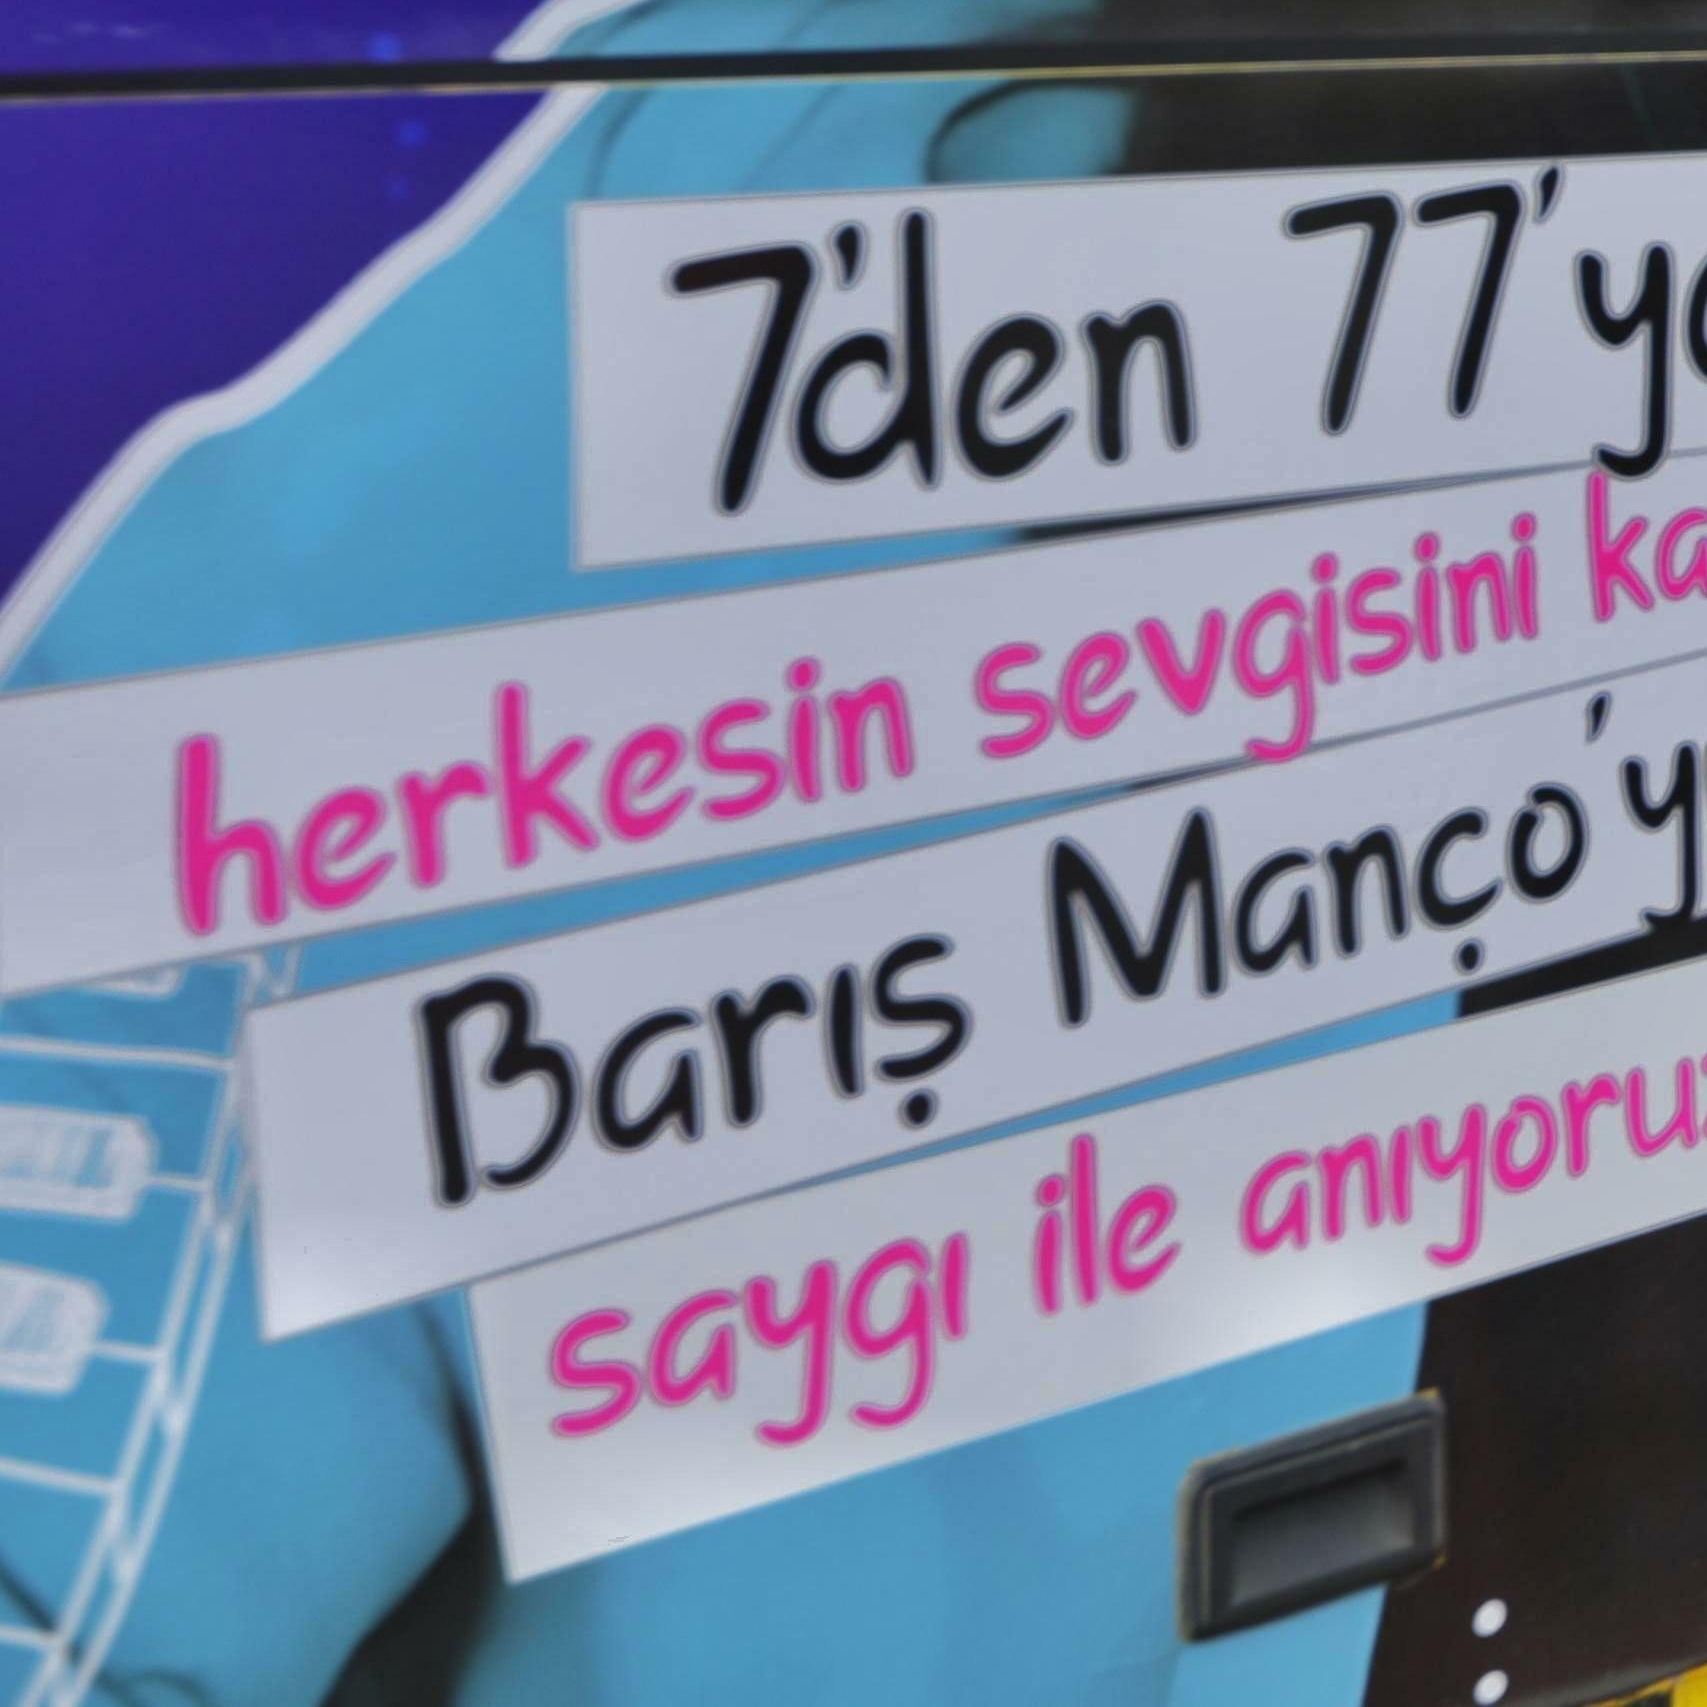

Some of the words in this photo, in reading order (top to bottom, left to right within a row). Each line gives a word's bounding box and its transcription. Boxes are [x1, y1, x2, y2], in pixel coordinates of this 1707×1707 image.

[668, 206, 1199, 516] 7'den
[174, 662, 916, 935] herkesin
[972, 508, 1543, 764] sevgisini
[412, 931, 974, 1208] Barış
[545, 1230, 971, 1449] saygı
[1029, 1132, 1181, 1318] ile
